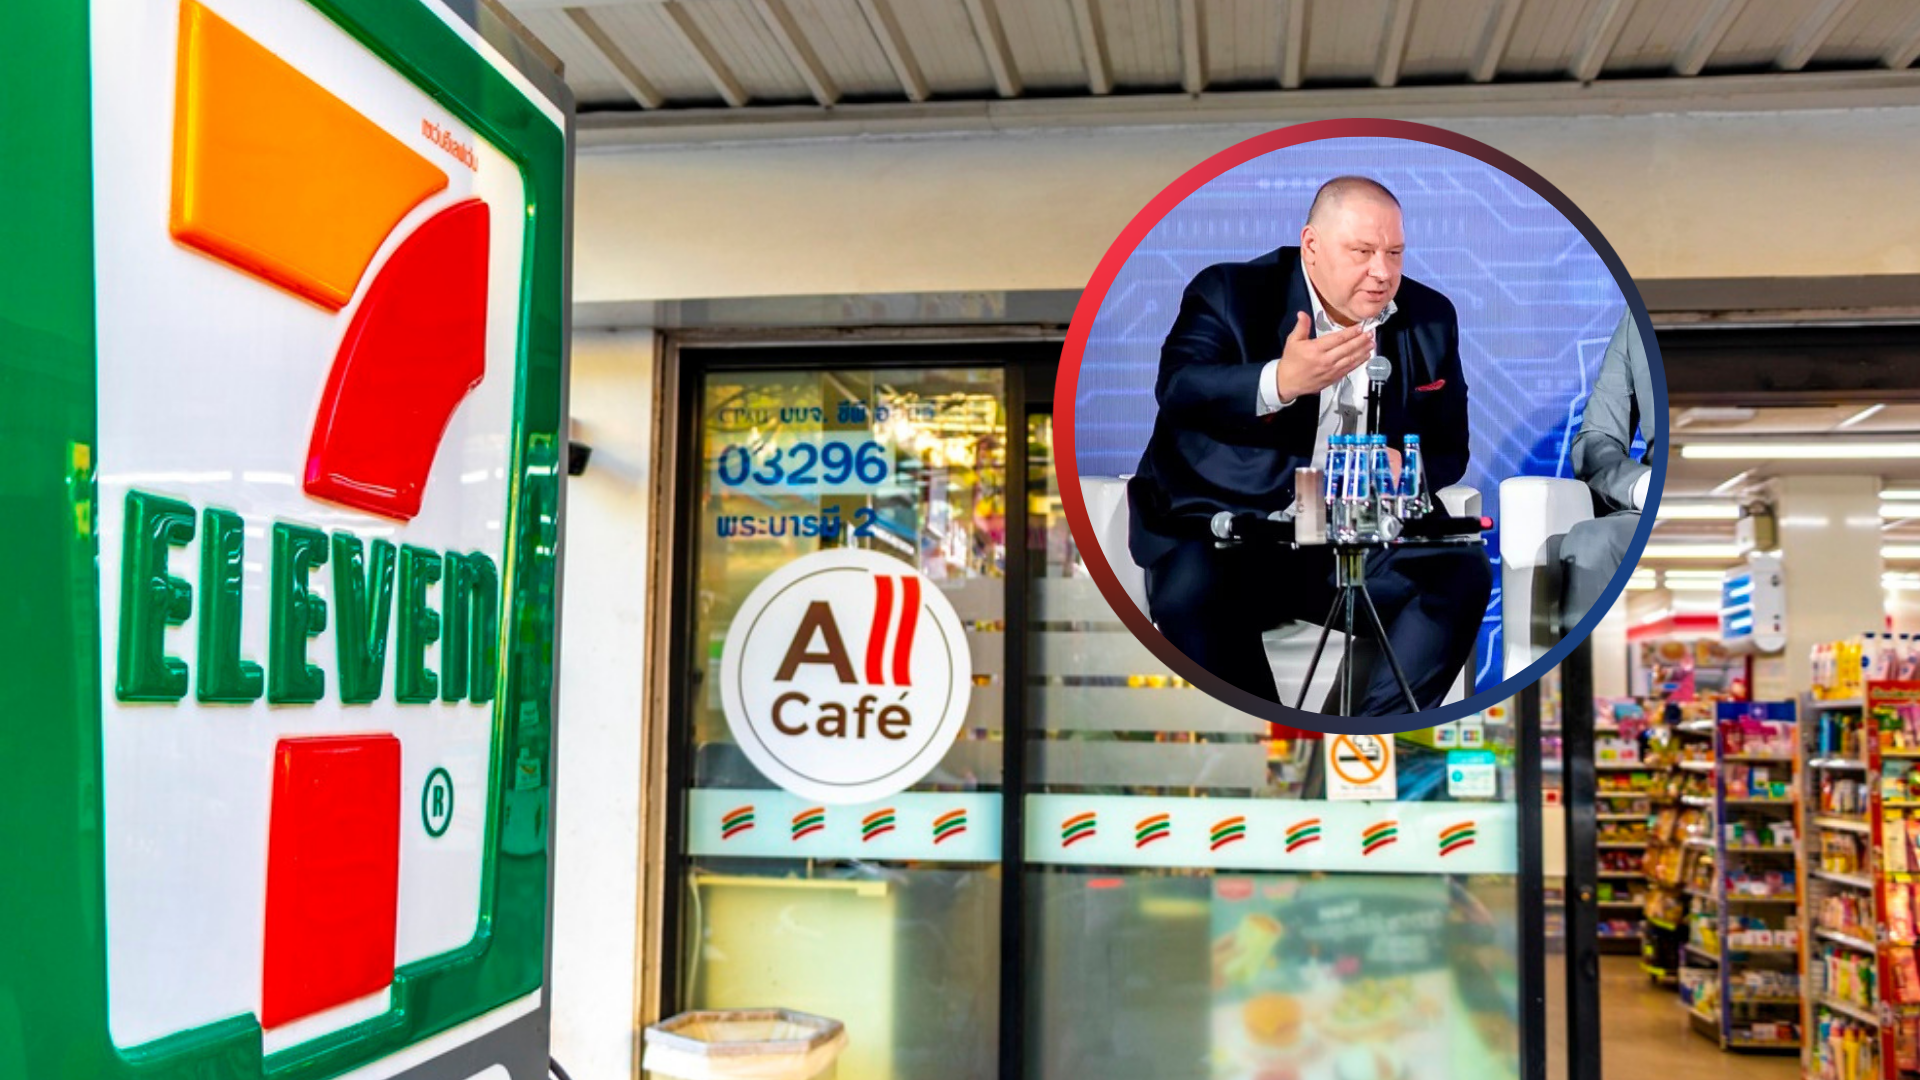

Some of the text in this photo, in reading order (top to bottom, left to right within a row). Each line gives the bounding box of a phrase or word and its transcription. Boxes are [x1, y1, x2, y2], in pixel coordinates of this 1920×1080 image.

[718, 440, 888, 486] 03296
[716, 504, 879, 538] พระบารมี 2
[773, 575, 921, 687] All
[771, 691, 912, 741] Café
